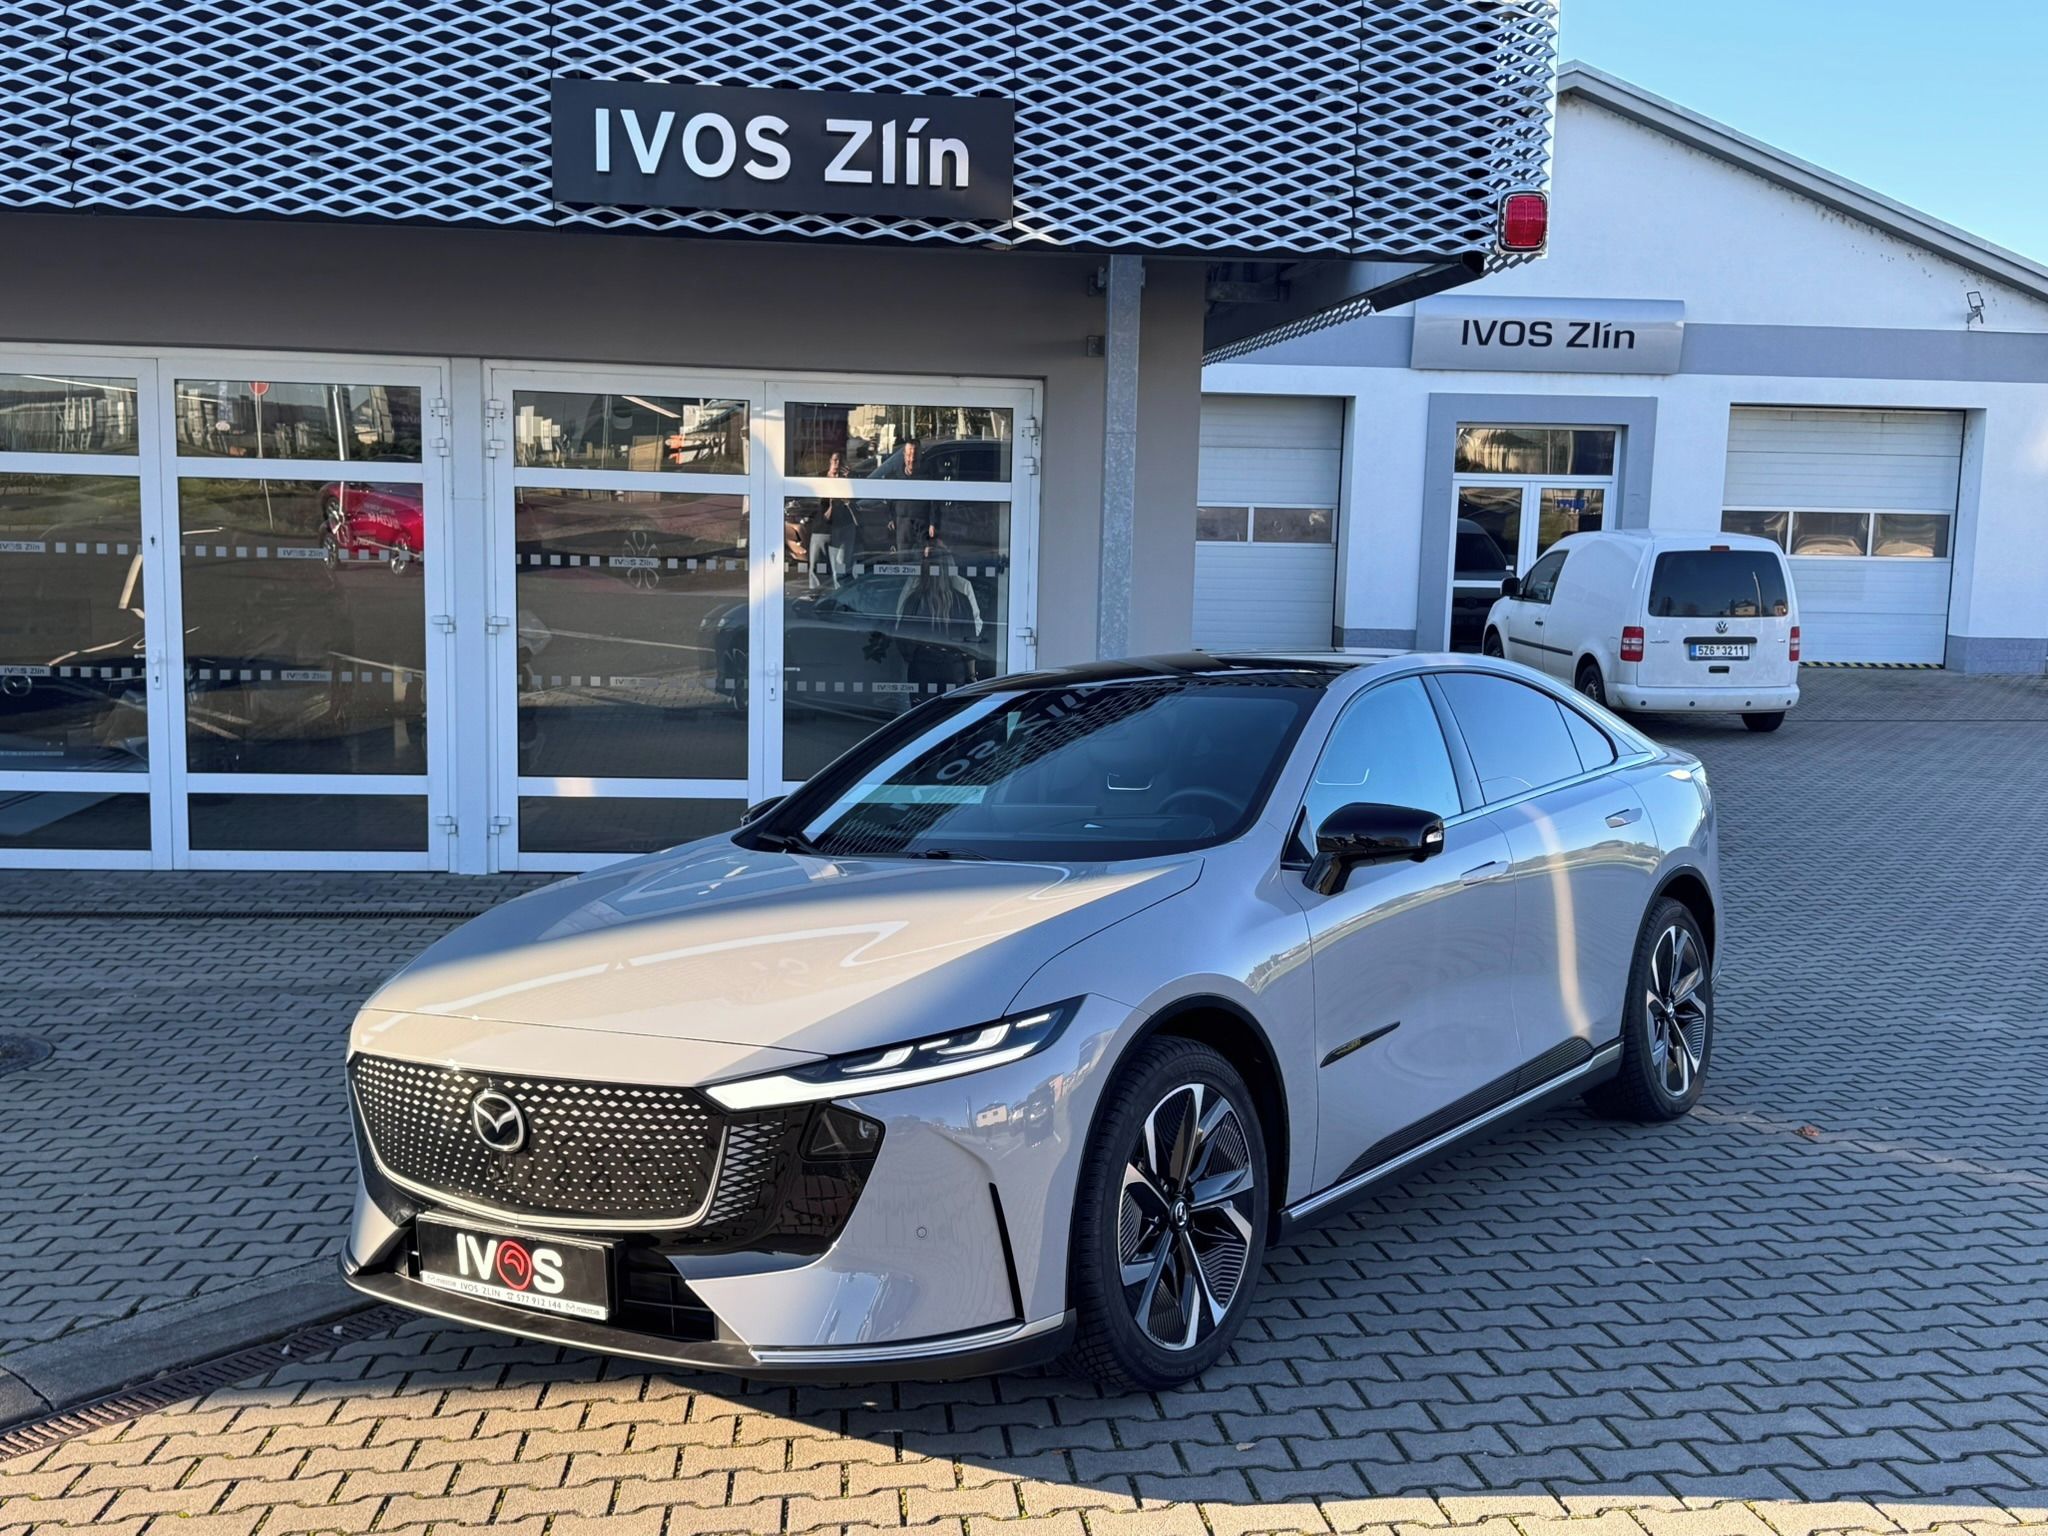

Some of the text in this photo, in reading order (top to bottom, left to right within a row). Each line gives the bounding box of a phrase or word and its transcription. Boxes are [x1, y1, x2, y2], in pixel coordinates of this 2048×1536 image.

[595, 107, 969, 187] IVOS Zlín
[1461, 319, 1635, 349] IVOS Zlín
[1698, 645, 1715, 656] 5Z6
[1721, 645, 1745, 656] 3211
[456, 1233, 565, 1294] IVOS
[460, 1281, 479, 1293] IVOS
[516, 1294, 529, 1302] 577
[532, 1297, 545, 1305] 912
[549, 1299, 561, 1309] 144
